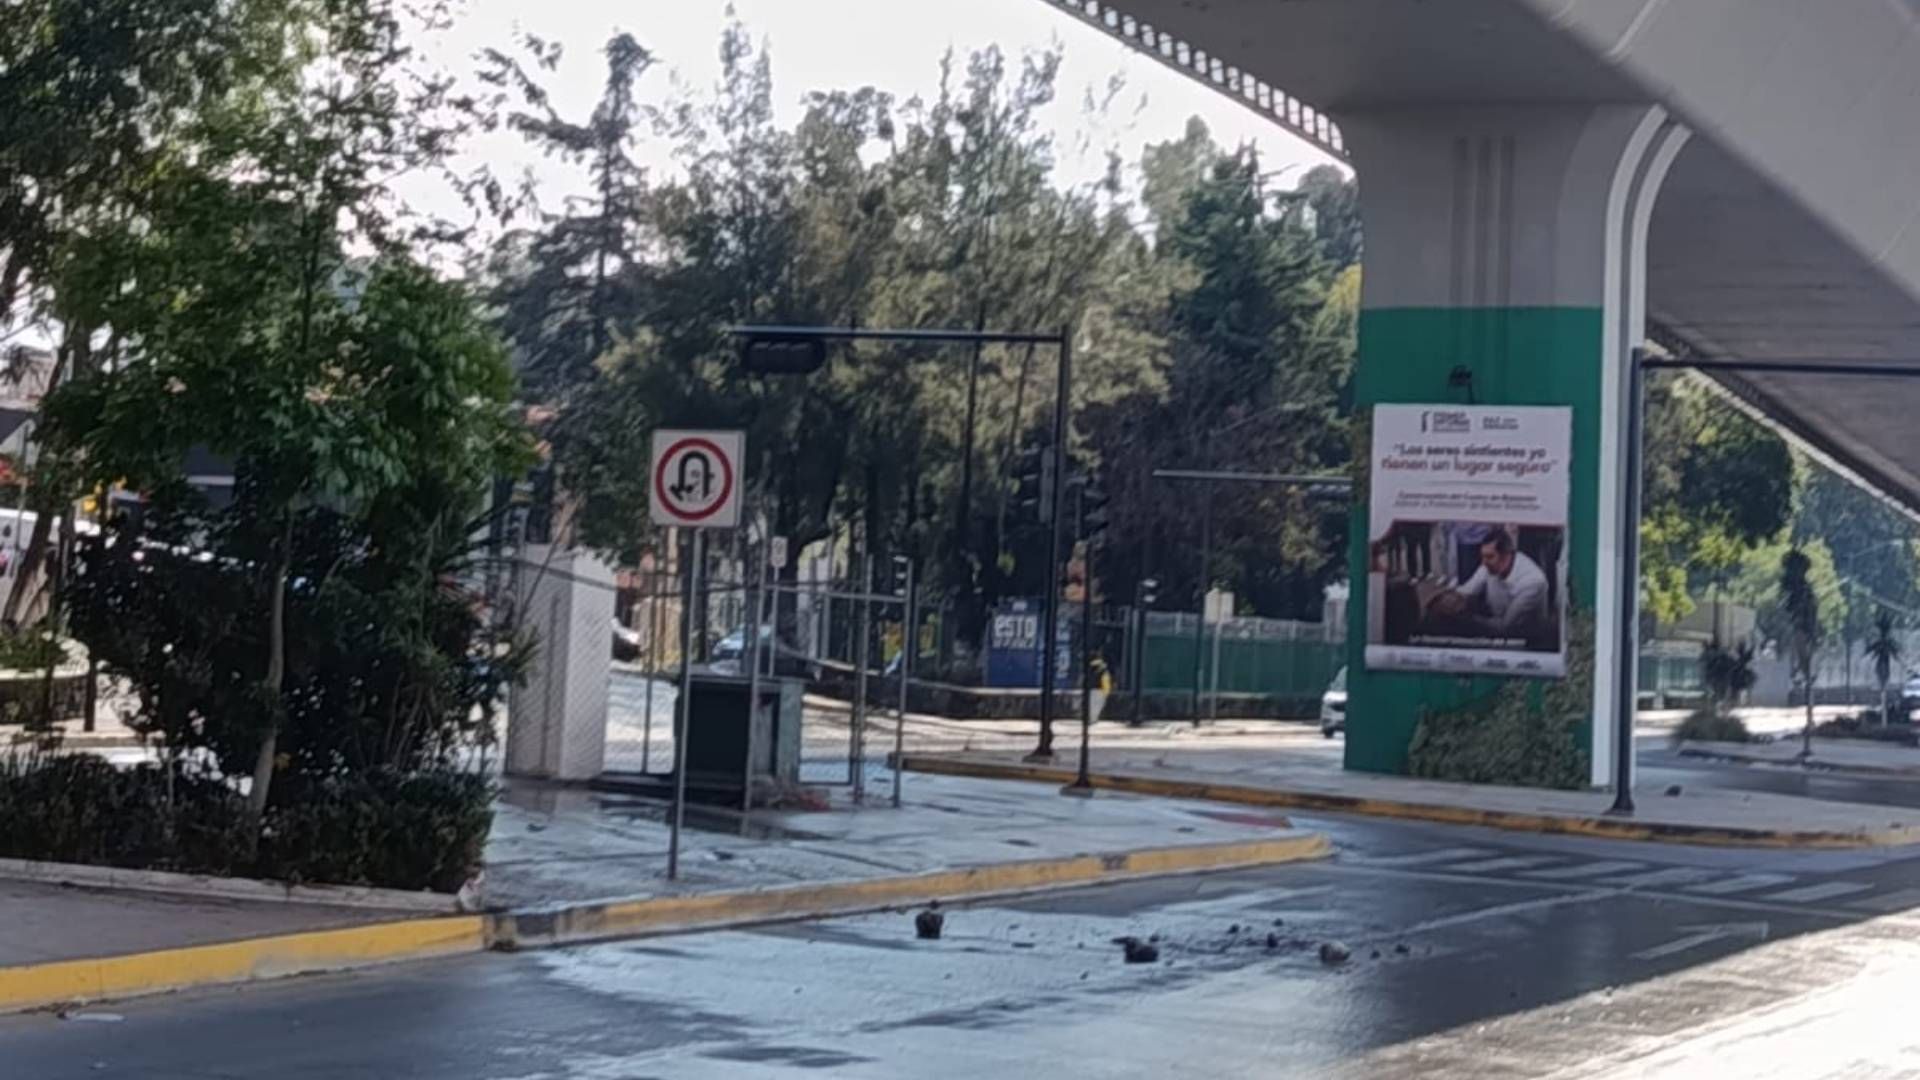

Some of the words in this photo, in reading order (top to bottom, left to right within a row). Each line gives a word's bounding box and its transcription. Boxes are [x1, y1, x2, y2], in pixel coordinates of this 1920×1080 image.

[1427, 446, 1460, 456] seres
[1381, 456, 1428, 470] tienen
[1432, 459, 1450, 471] un
[1454, 456, 1494, 476] lugar
